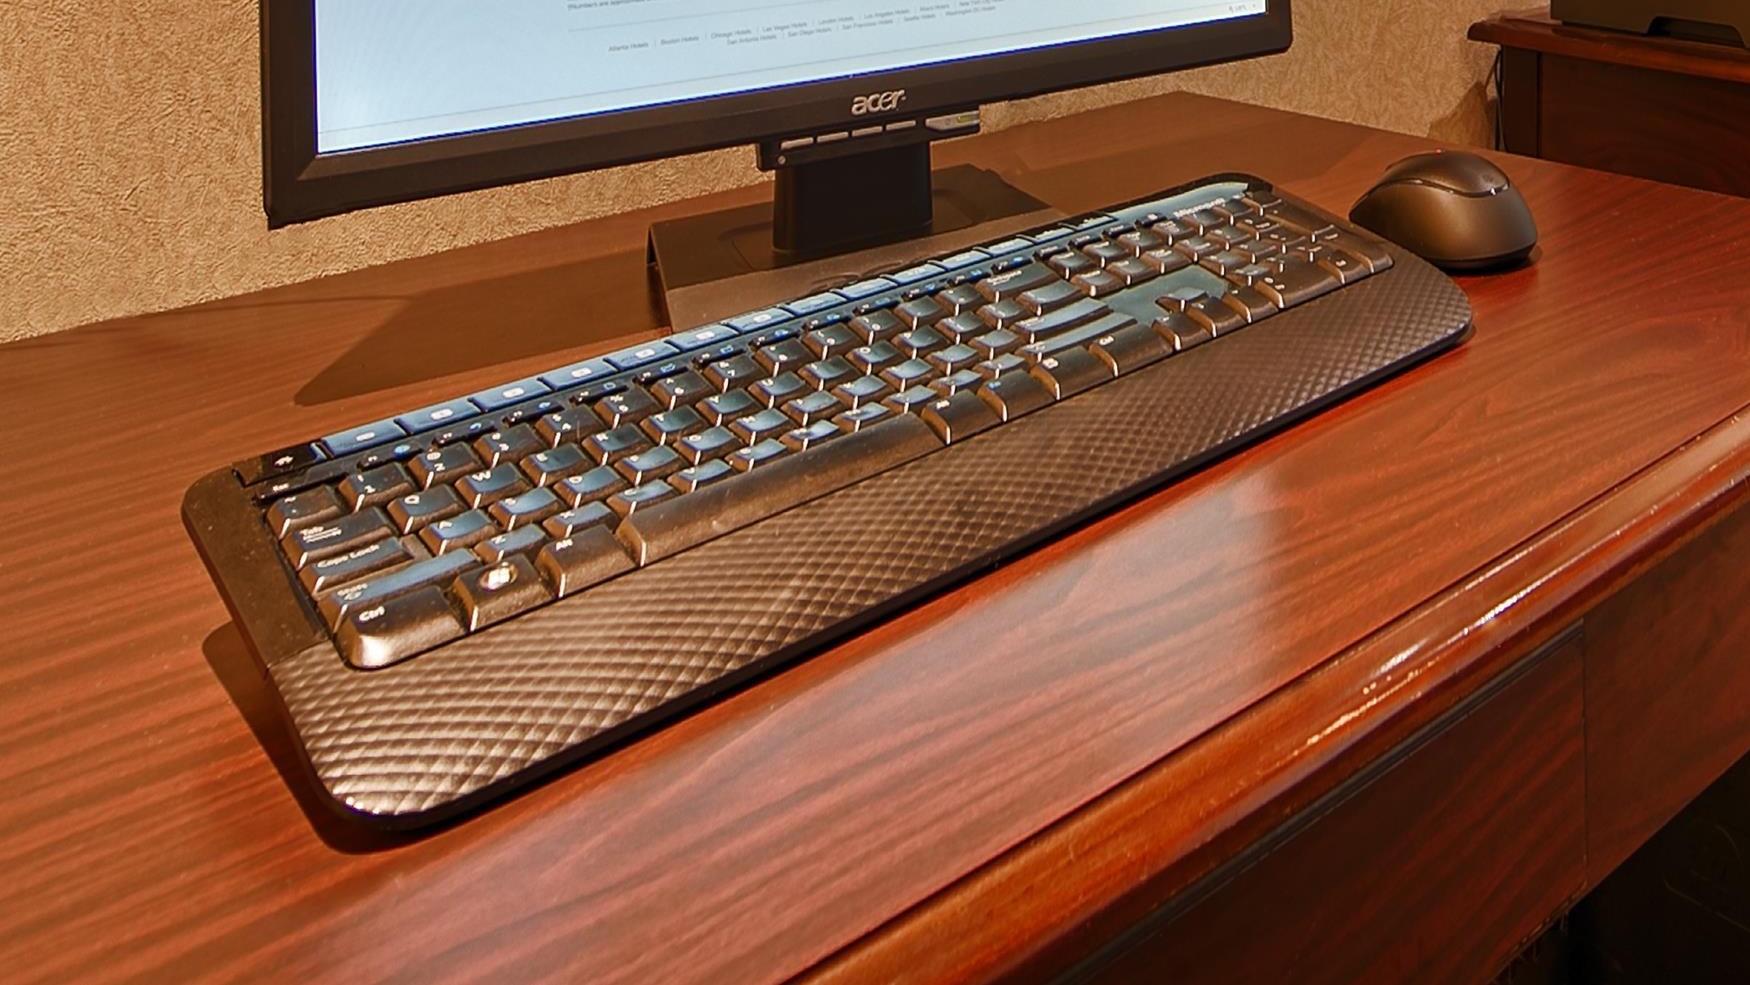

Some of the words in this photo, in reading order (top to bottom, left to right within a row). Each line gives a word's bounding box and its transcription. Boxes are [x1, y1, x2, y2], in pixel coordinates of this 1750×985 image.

[851, 89, 906, 115] acer
[472, 470, 491, 482] W
[301, 525, 324, 536] Tab
[555, 538, 573, 552] Alt
[318, 554, 348, 568] Caps
[350, 544, 380, 559] Lock
[359, 606, 385, 622] Ctrl
